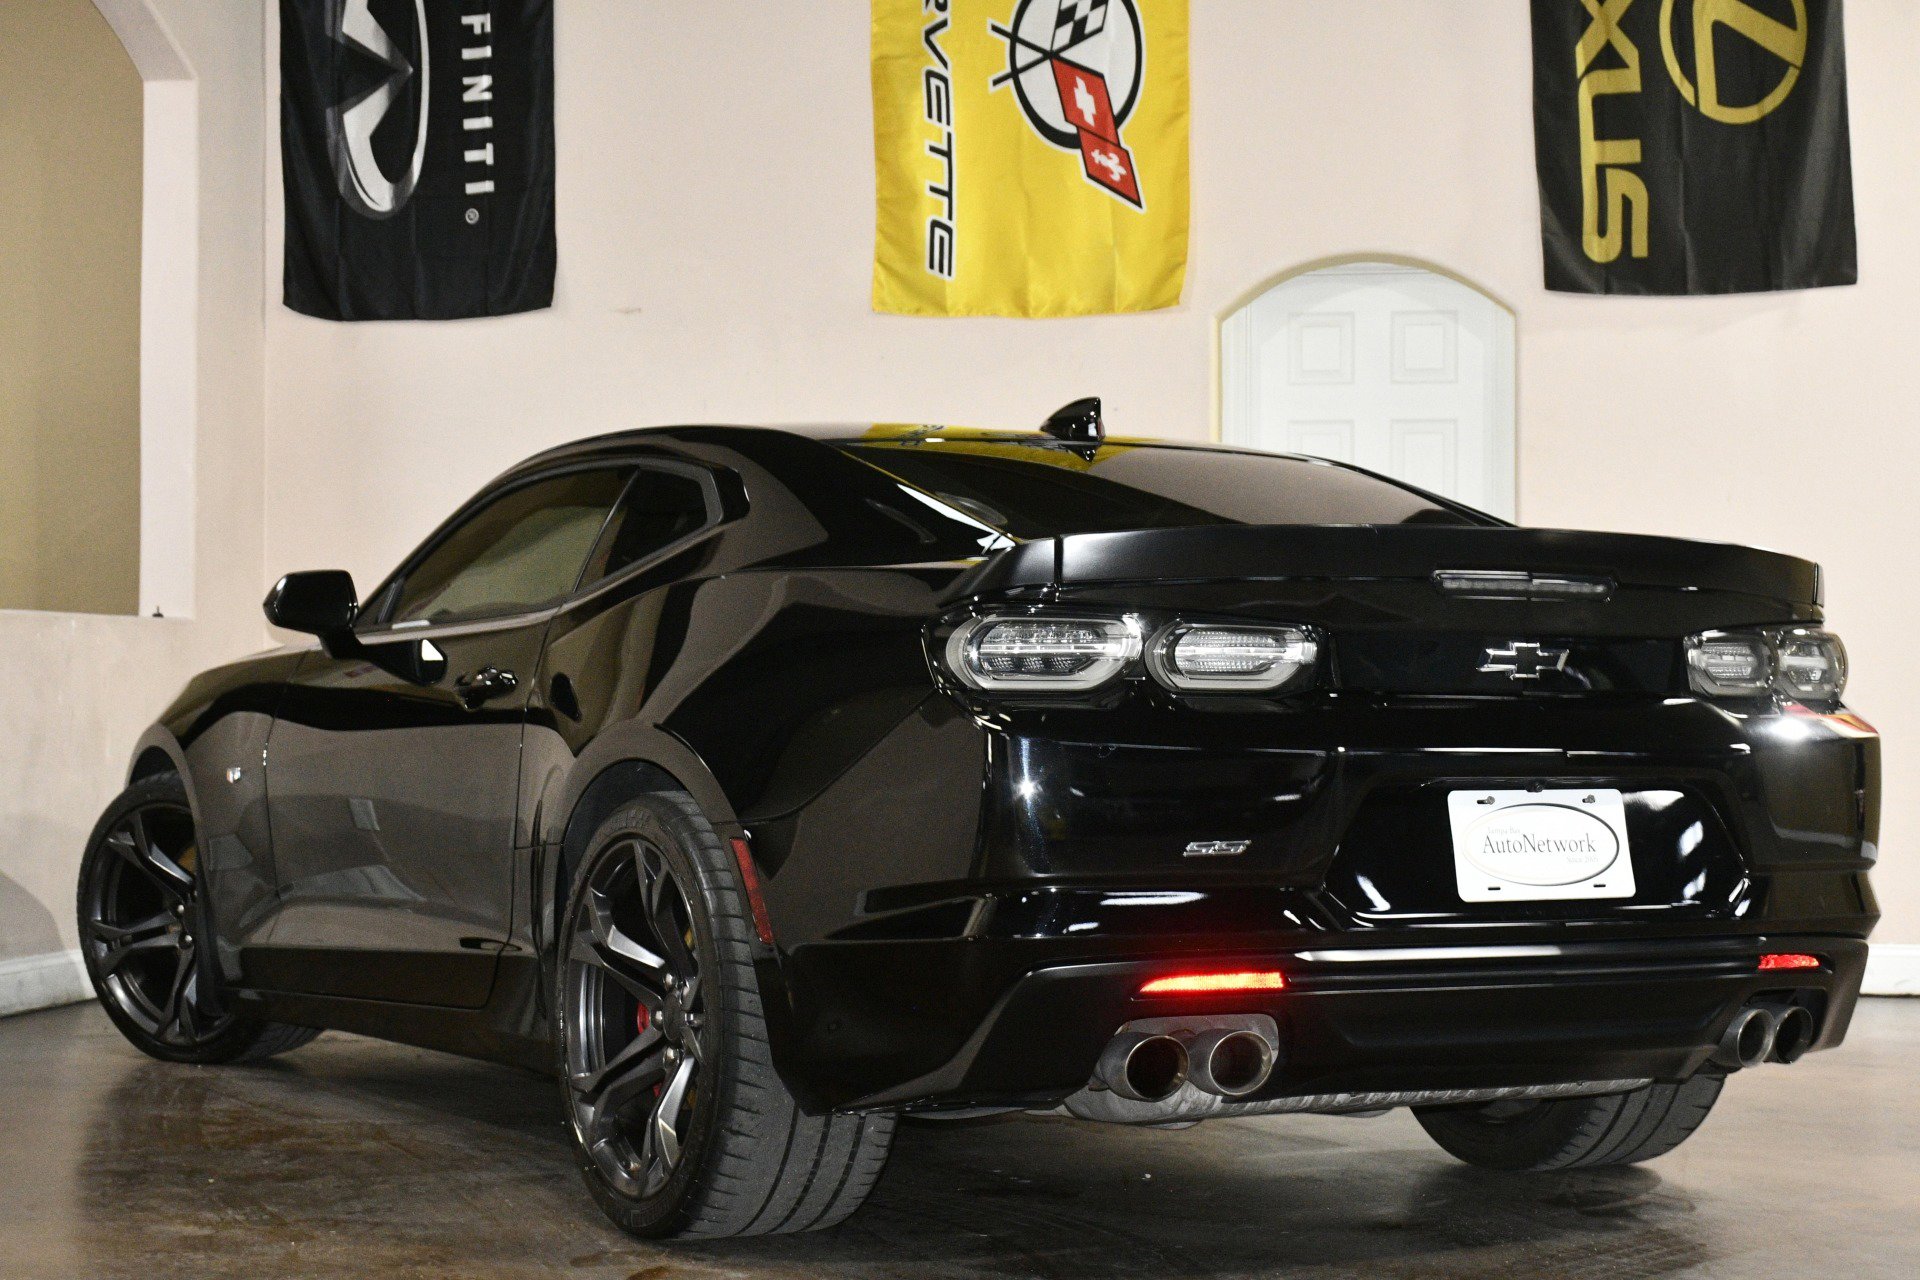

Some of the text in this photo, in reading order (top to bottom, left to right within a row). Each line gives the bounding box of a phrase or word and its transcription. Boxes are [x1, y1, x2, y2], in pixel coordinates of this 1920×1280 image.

[924, 0, 954, 278] VETTE
[1183, 839, 1252, 857] SS
[1482, 832, 1597, 854] AutoNetwork
